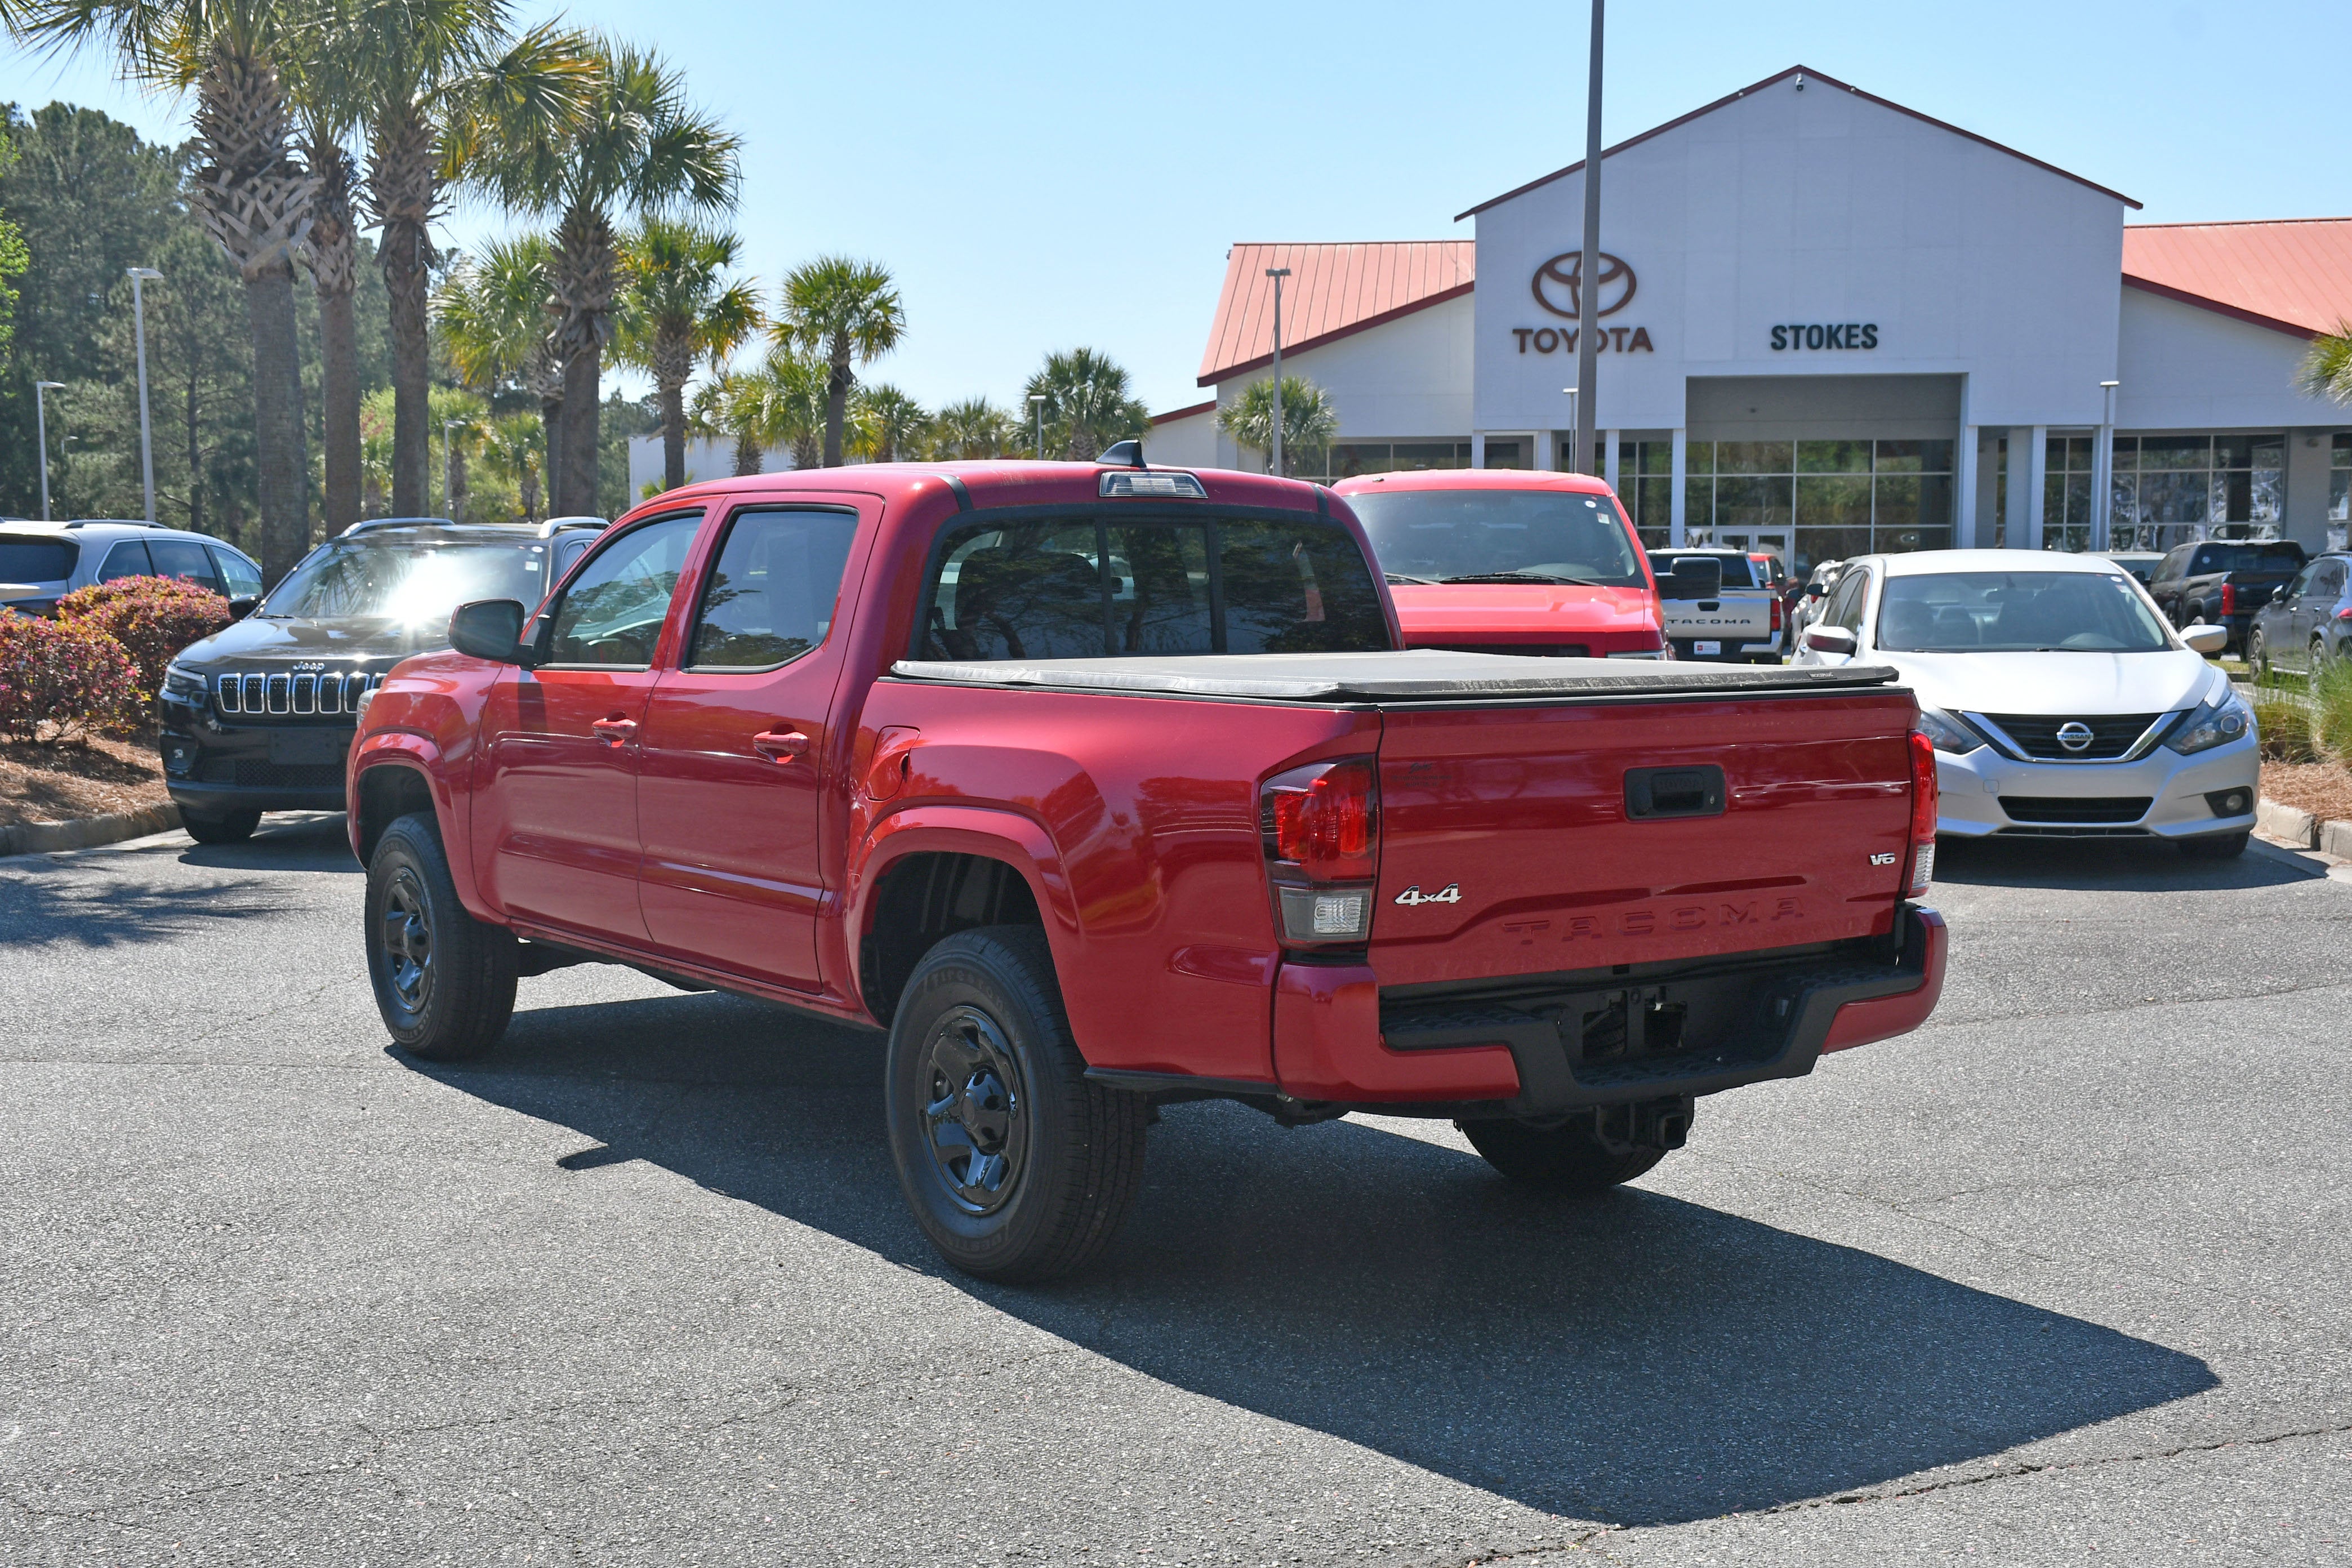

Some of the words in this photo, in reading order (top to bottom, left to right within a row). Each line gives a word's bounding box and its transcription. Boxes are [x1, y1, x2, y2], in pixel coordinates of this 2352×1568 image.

[1770, 323, 1878, 350] STOKES
[292, 661, 325, 672] Jeep
[1870, 852, 1896, 866] V6
[1395, 883, 1463, 906] 4x4
[1503, 897, 1803, 945] TACOMA
